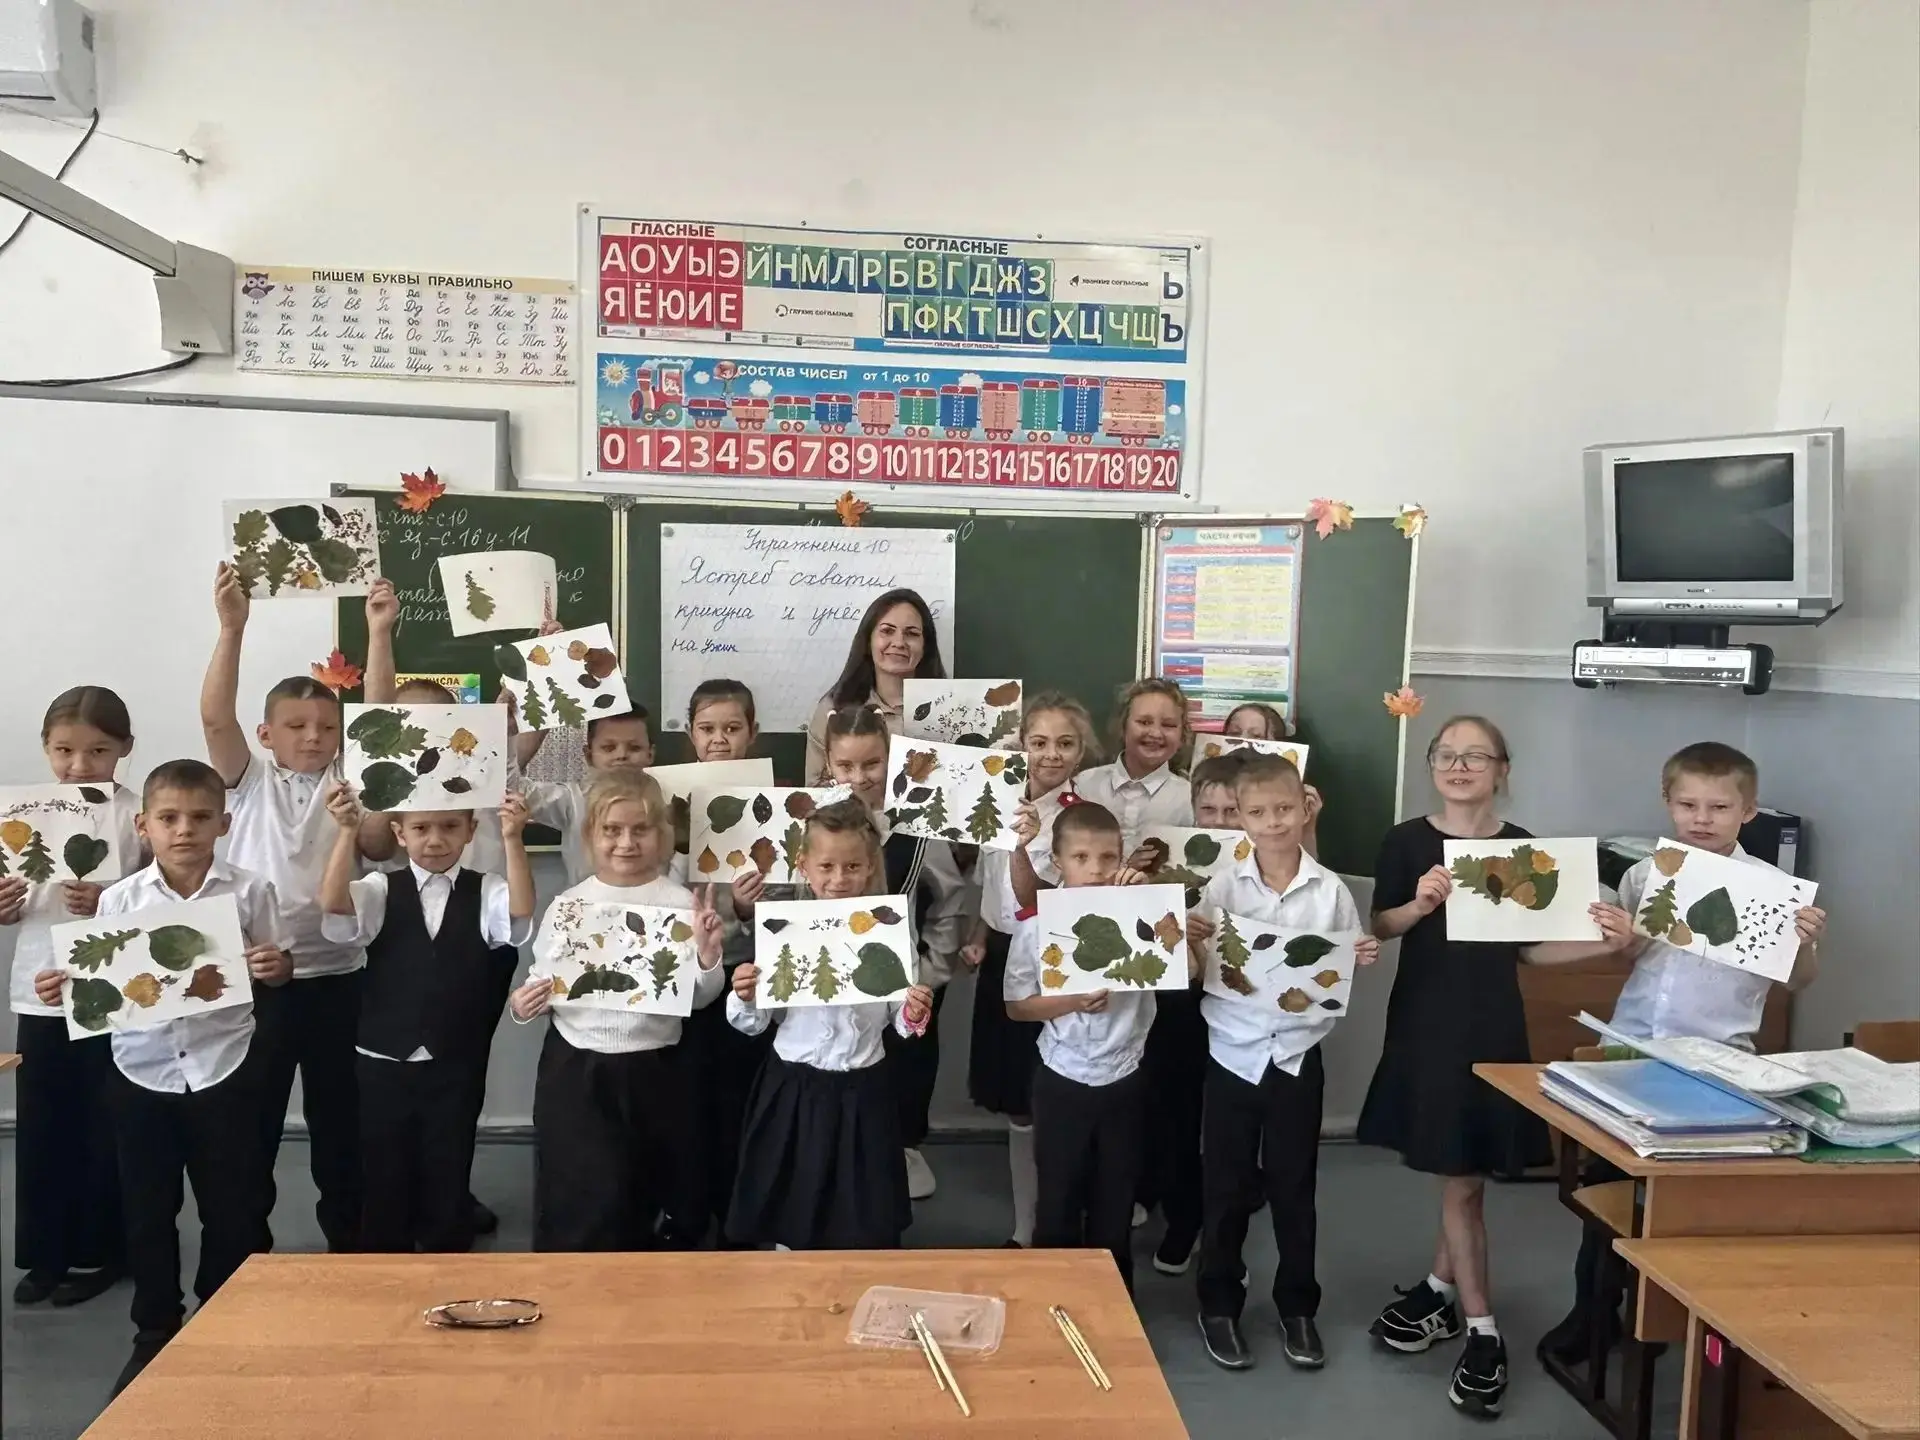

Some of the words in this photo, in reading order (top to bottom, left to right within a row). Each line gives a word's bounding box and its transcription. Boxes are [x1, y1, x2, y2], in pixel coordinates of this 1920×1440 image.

[630, 222, 716, 238] ГЛАСНЫЕ
[903, 236, 1009, 256] СОГЛАСНЫЕ
[312, 271, 365, 283] ПИШЕМ
[372, 273, 420, 285] БУКВЫ
[428, 276, 513, 289] ПРАВИЛЬНО
[738, 364, 796, 378] СОСТАВ
[800, 367, 848, 380] ЧИСЕЛ
[915, 371, 930, 383] 10
[744, 527, 861, 561] Упражнение
[866, 539, 890, 552] 10
[681, 556, 790, 596] Ястреб
[789, 562, 898, 588] схватил
[674, 603, 755, 631] крикуна
[781, 605, 796, 620] и
[807, 601, 861, 636] унёс
[671, 638, 698, 652] на
